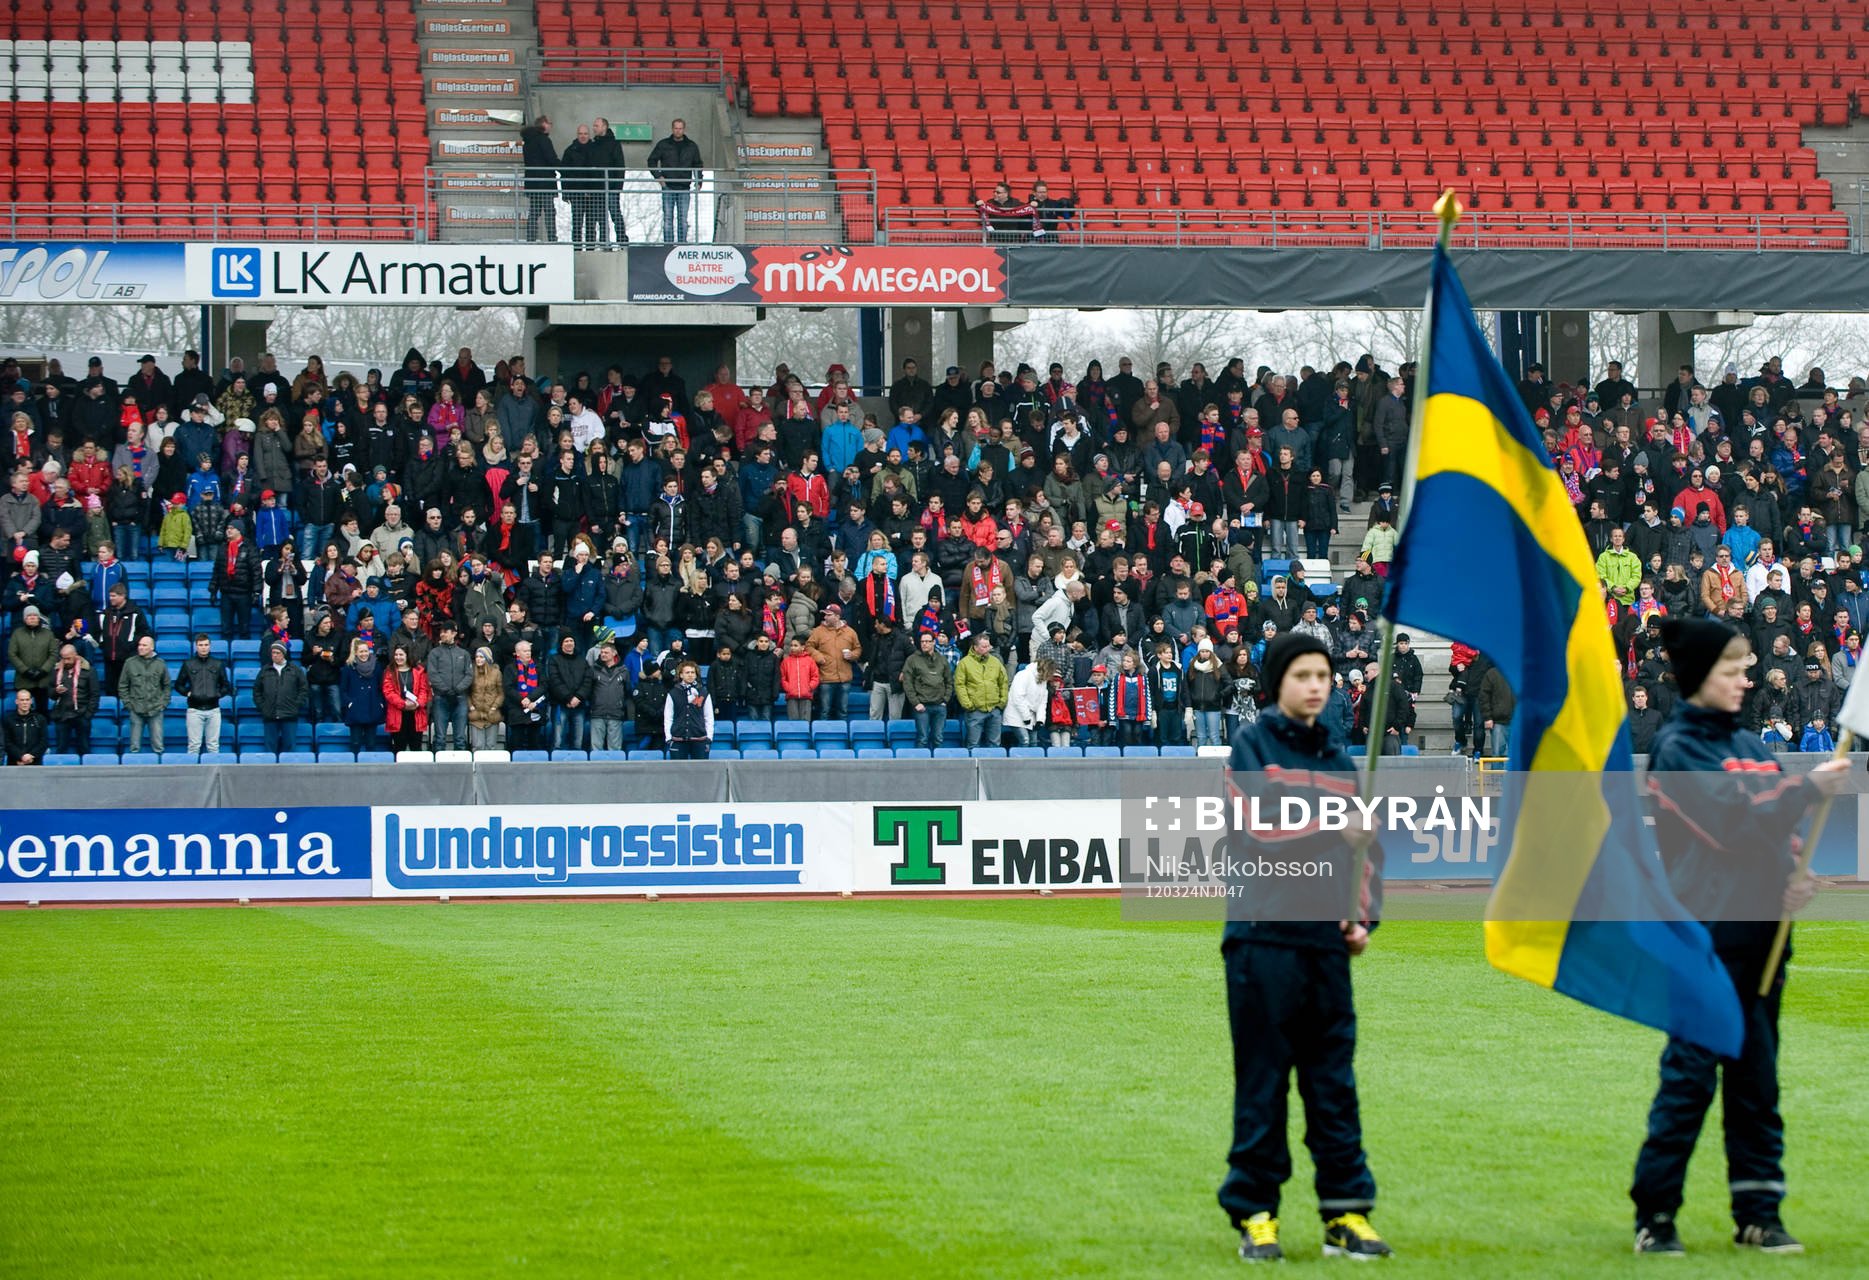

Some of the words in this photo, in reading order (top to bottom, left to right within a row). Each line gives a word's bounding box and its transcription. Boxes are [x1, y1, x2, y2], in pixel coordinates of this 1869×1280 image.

[495, 24, 506, 32] AB
[432, 53, 497, 62] BilglasExperten
[499, 53, 509, 62] AB
[436, 82, 501, 92] BilglasExperten
[503, 83, 514, 92] AB
[440, 112, 489, 122] BilglasExpe
[801, 147, 813, 156] AB
[744, 210, 813, 221] ilglasExperten
[814, 211, 827, 220] AB
[677, 251, 698, 260] MER
[701, 251, 733, 260] MUSIK
[273, 251, 330, 294] LK
[341, 251, 547, 296] Armatur
[676, 275, 735, 285] BLANDNING
[852, 267, 996, 293] MEGAPOL
[113, 286, 135, 297] AB
[0, 811, 341, 878] emannia
[385, 812, 804, 890] Lundagrossisten
